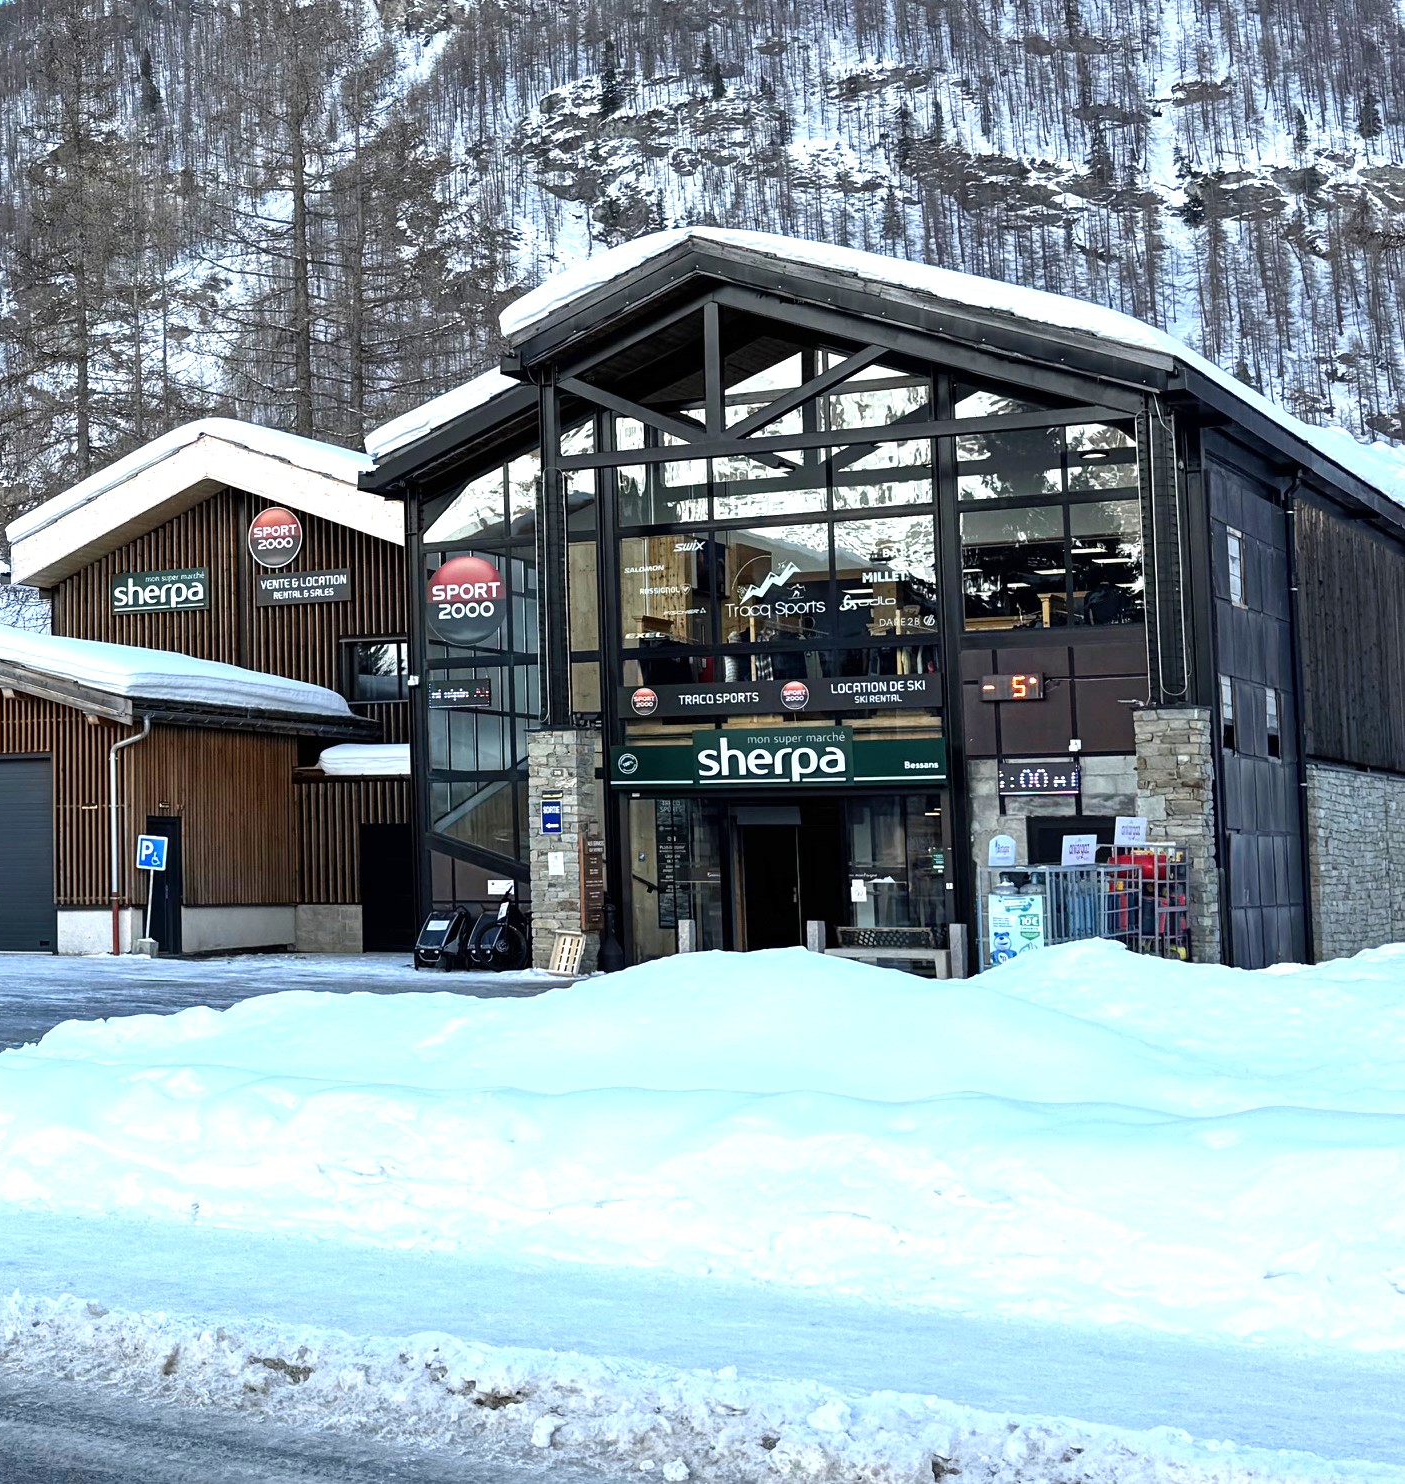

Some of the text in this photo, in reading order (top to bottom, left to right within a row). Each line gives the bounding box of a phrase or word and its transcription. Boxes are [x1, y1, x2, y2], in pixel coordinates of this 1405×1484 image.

[253, 523, 297, 538] SPORT
[257, 537, 294, 550] 2000
[161, 574, 179, 583] super
[180, 571, 205, 580] marché
[624, 565, 665, 574] SALOMON
[260, 574, 347, 590] VENTE & LOCATION
[113, 577, 204, 608] sherpa
[273, 587, 335, 600] RENTAL & SALES
[431, 581, 501, 601] SPORT
[438, 600, 495, 620] 2000
[724, 600, 826, 619] Tracq Sports
[830, 679, 926, 694] LOCATION DE SKI
[678, 691, 760, 705] TRACQ SPORTS
[854, 694, 903, 704] SKI RENTAL
[747, 731, 846, 746] mon super marché
[697, 737, 846, 782] sherpa
[903, 760, 940, 770] Bessans
[140, 840, 154, 861] P
